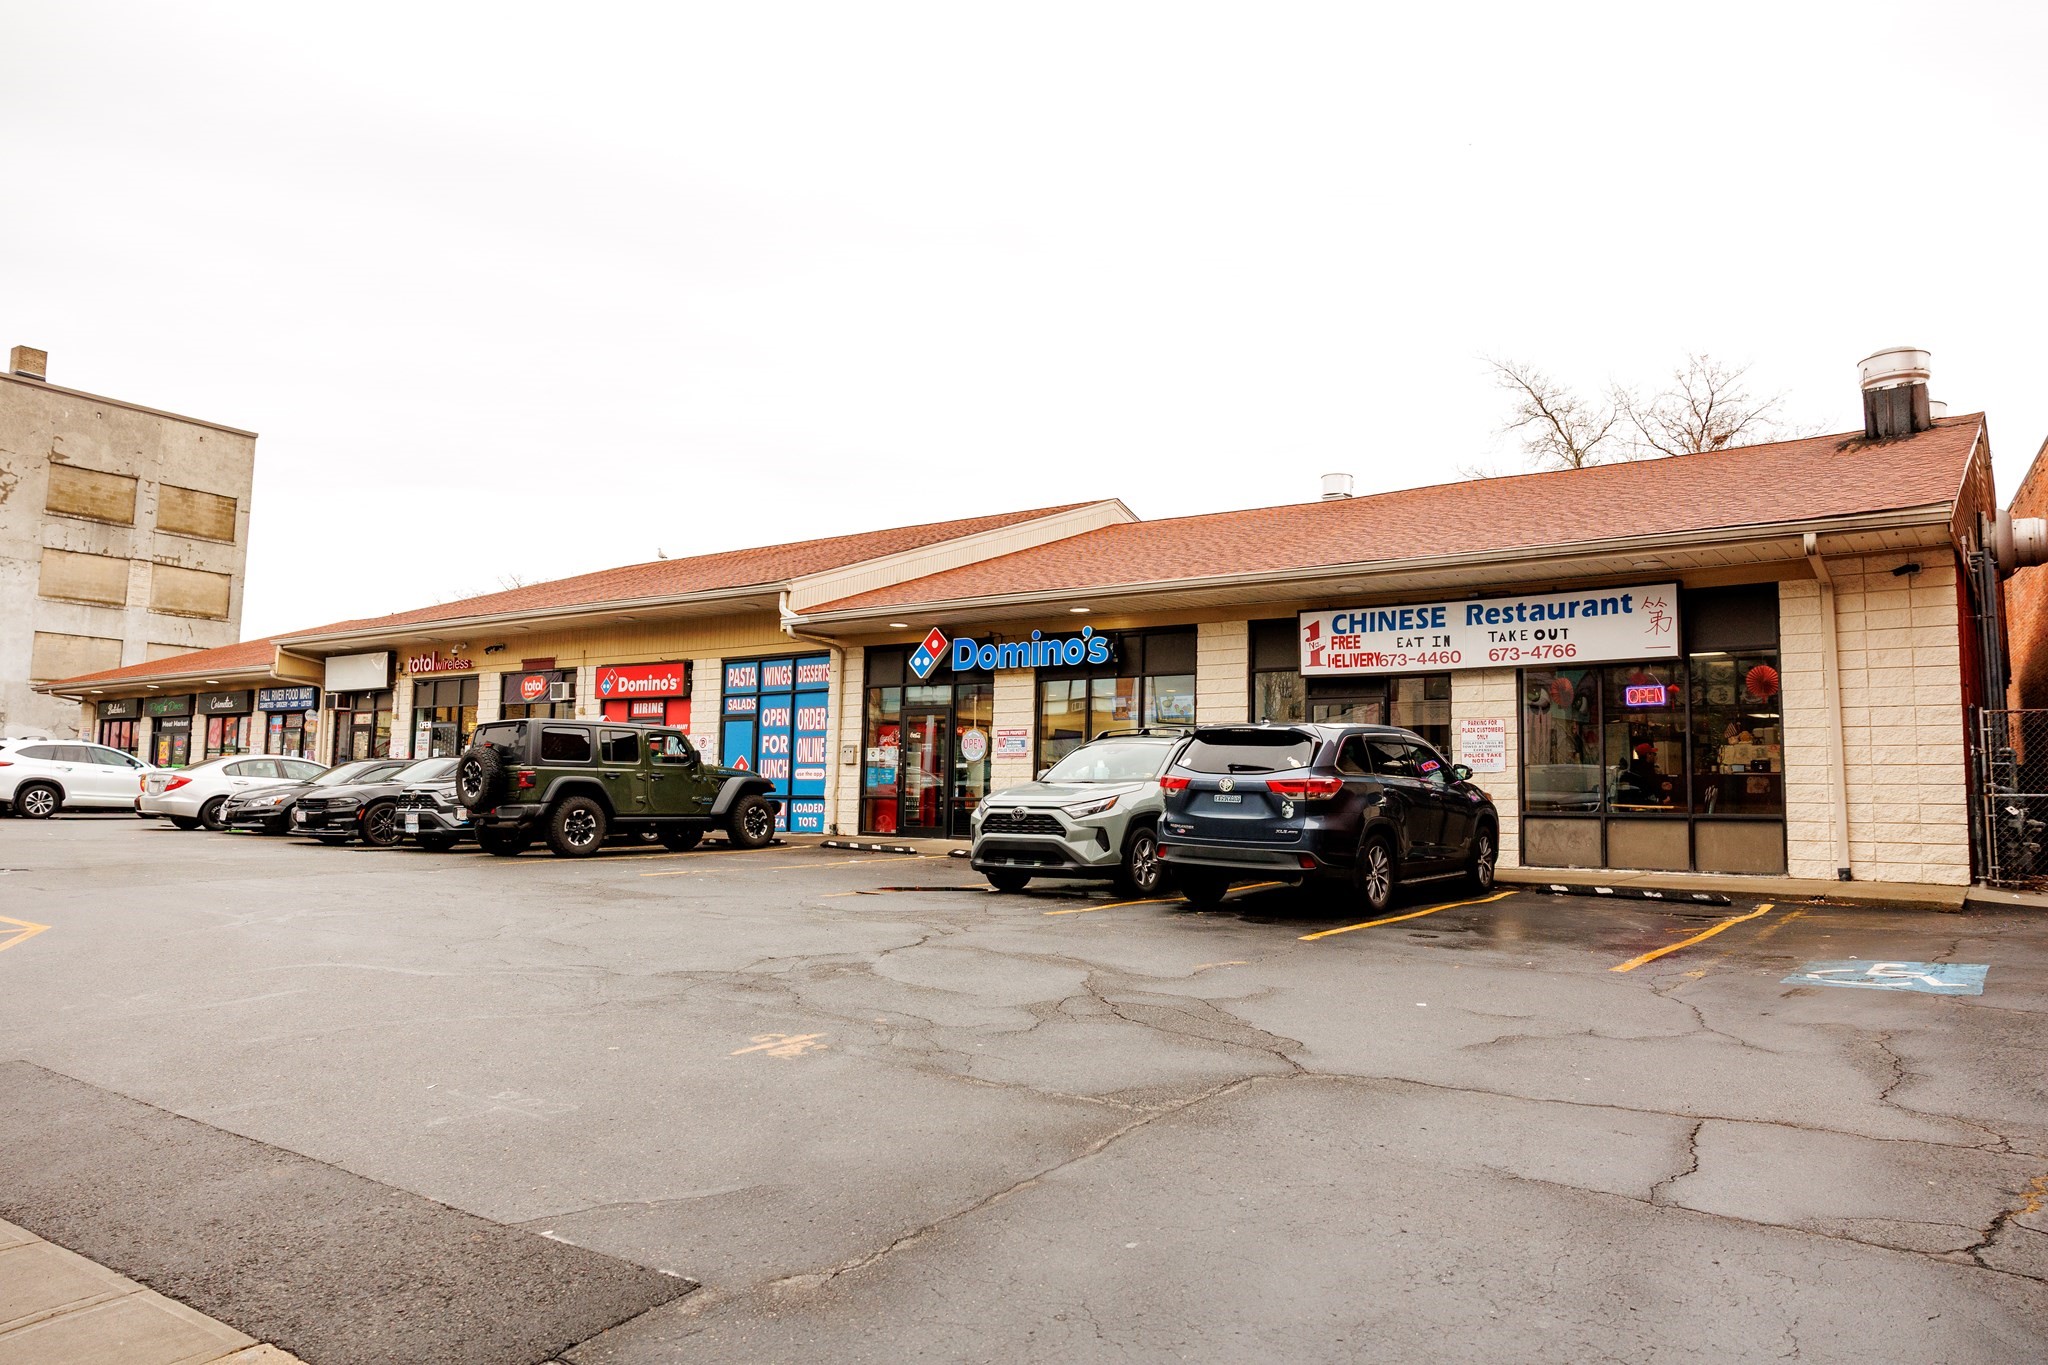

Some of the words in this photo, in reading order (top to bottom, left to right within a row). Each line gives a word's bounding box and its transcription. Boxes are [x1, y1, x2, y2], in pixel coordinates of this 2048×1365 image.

[1332, 606, 1446, 634] CHINESE
[1466, 593, 1633, 626] Restaurant
[1331, 635, 1361, 650] FREE
[1397, 637, 1424, 648] EAT
[1432, 635, 1451, 647] IN
[1488, 629, 1528, 643] TAKE
[1533, 628, 1569, 641] OUT
[952, 625, 1110, 671] Domino's
[1488, 643, 1577, 662] 673-4766
[408, 651, 436, 673] total
[435, 658, 470, 671] wireless
[1379, 651, 1462, 667] 673-4460
[617, 673, 678, 693] Domino's
[728, 666, 757, 688] PASTA
[763, 665, 792, 686] WINGS
[797, 663, 830, 683] DESSERTS
[524, 678, 543, 692] total
[260, 690, 270, 701] FALL
[271, 689, 284, 701] RIVER
[285, 688, 298, 700] FOOD
[300, 687, 313, 699] MART
[1627, 688, 1663, 704] OPEN
[210, 696, 234, 709] Cosmetics
[633, 702, 664, 714] HIRING
[727, 698, 756, 711] SALADS
[762, 708, 790, 727] OPEN
[797, 707, 826, 731] ORDER
[762, 735, 788, 754] FOR
[796, 737, 825, 764] ONLINE
[963, 738, 983, 749] OPEN
[998, 737, 1006, 748] NO
[760, 759, 789, 779] LUNCH
[792, 802, 824, 813] LOADED
[798, 816, 818, 828] TOTS
